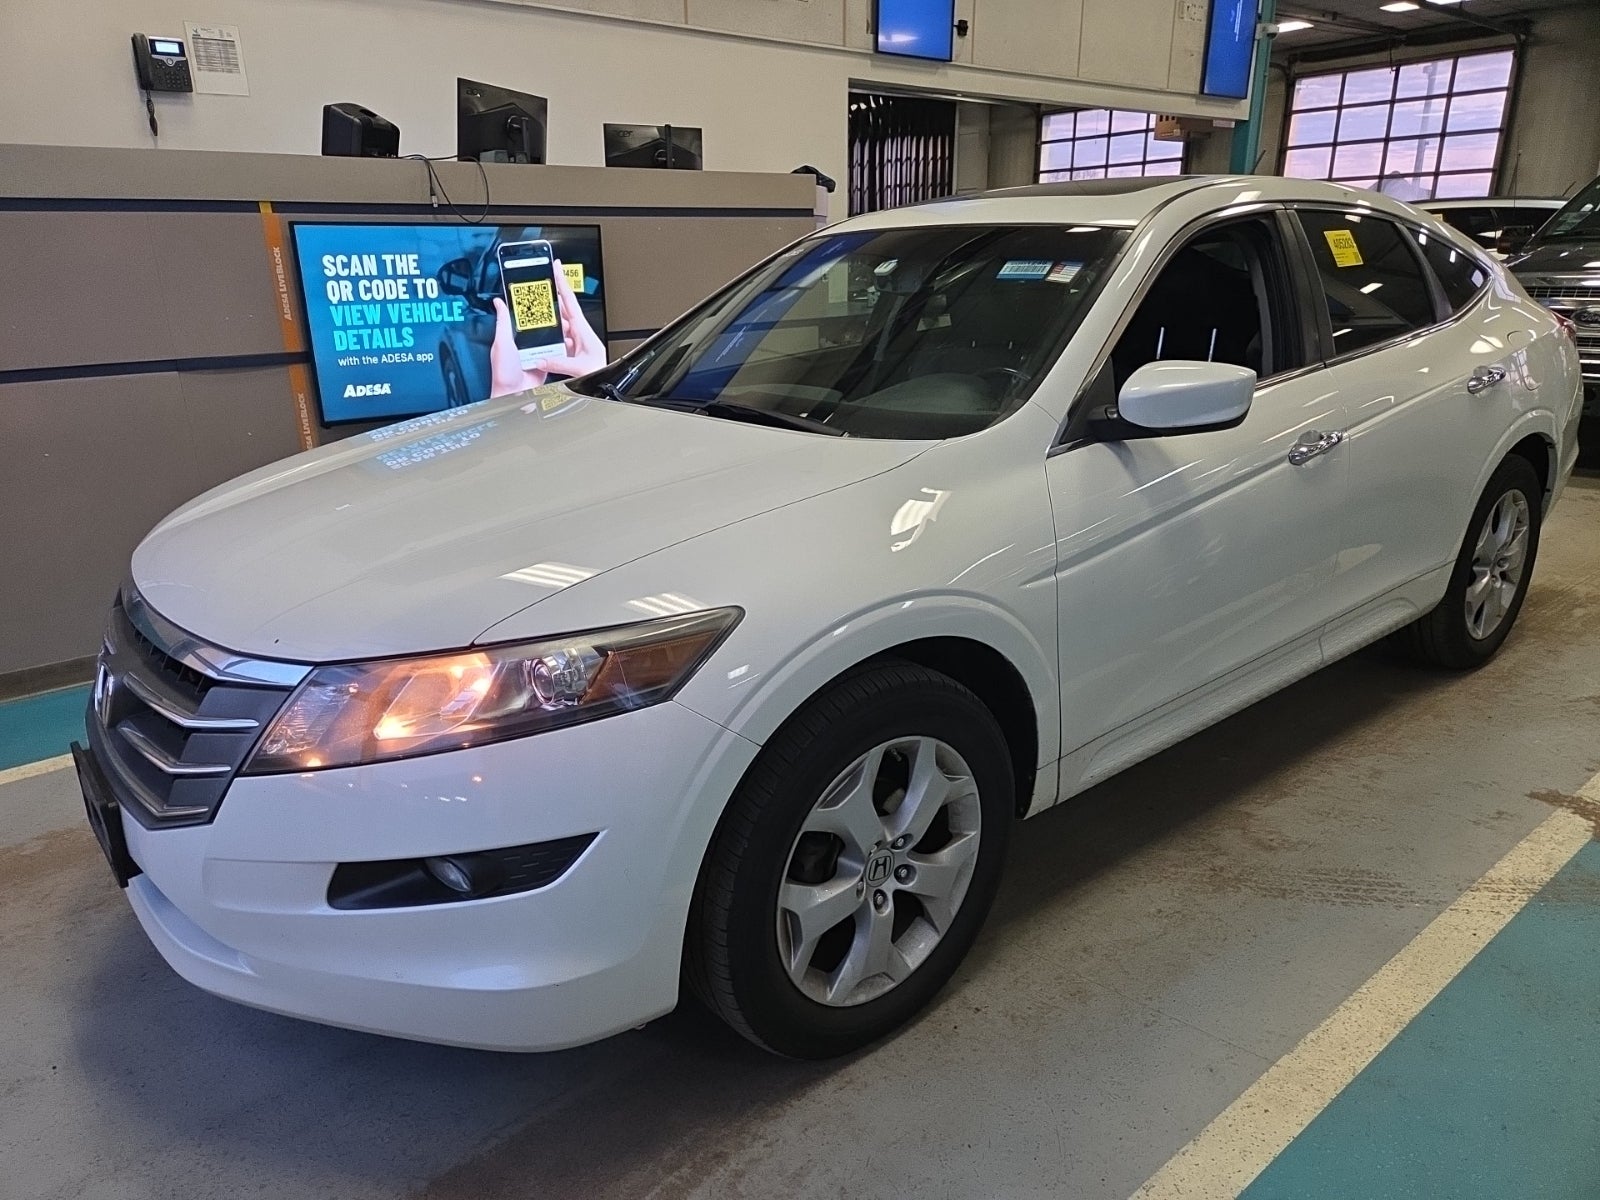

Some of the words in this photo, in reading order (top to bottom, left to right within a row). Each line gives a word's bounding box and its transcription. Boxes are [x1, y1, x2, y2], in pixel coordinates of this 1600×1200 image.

[322, 254, 378, 277] SCAN
[382, 254, 421, 276] THE
[326, 279, 354, 304] QR
[358, 278, 410, 301] CODE
[413, 277, 439, 299] TO
[281, 293, 292, 320] ADESA
[329, 303, 381, 327] VIEW
[386, 301, 465, 324] VEHICLE
[333, 326, 414, 351] DETAILS
[338, 355, 360, 367] with
[362, 355, 379, 365] the
[381, 352, 415, 364] ADESA
[416, 352, 434, 363] app
[343, 383, 391, 398] ADESA
